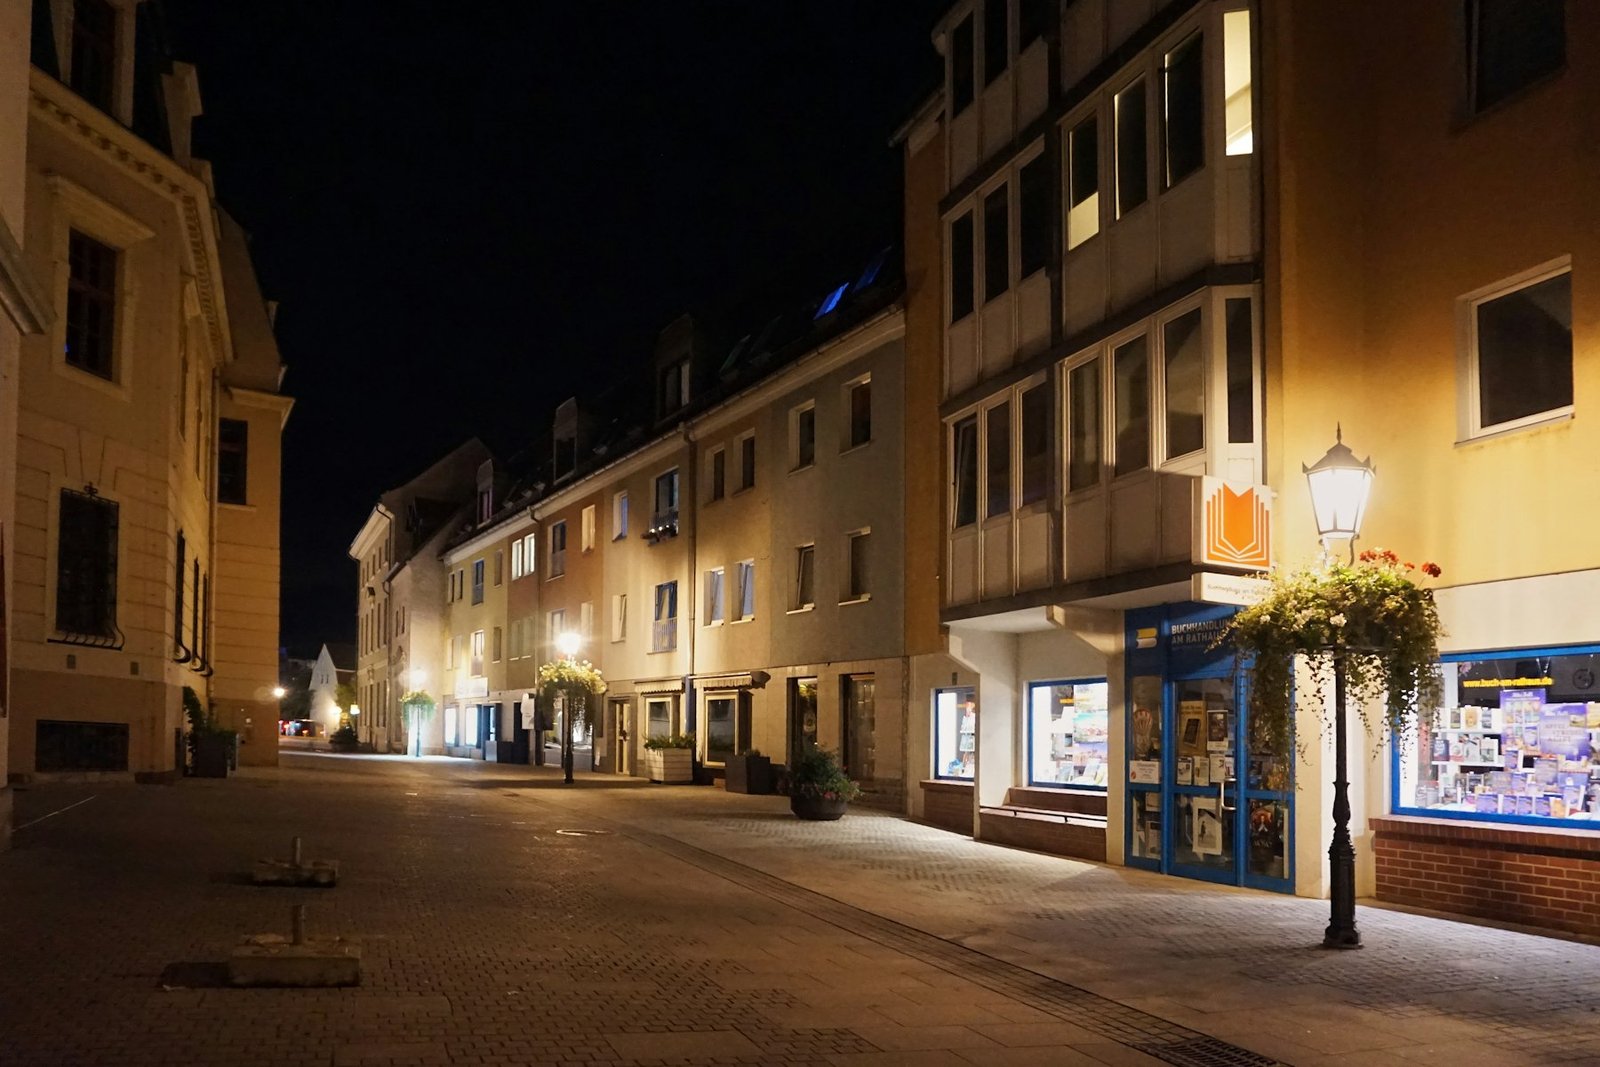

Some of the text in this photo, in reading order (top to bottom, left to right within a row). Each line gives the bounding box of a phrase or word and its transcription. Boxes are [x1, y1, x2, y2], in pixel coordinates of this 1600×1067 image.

[1171, 619, 1233, 634] BUCHHANDLUN
[1171, 631, 1221, 645] AM RATHAU
